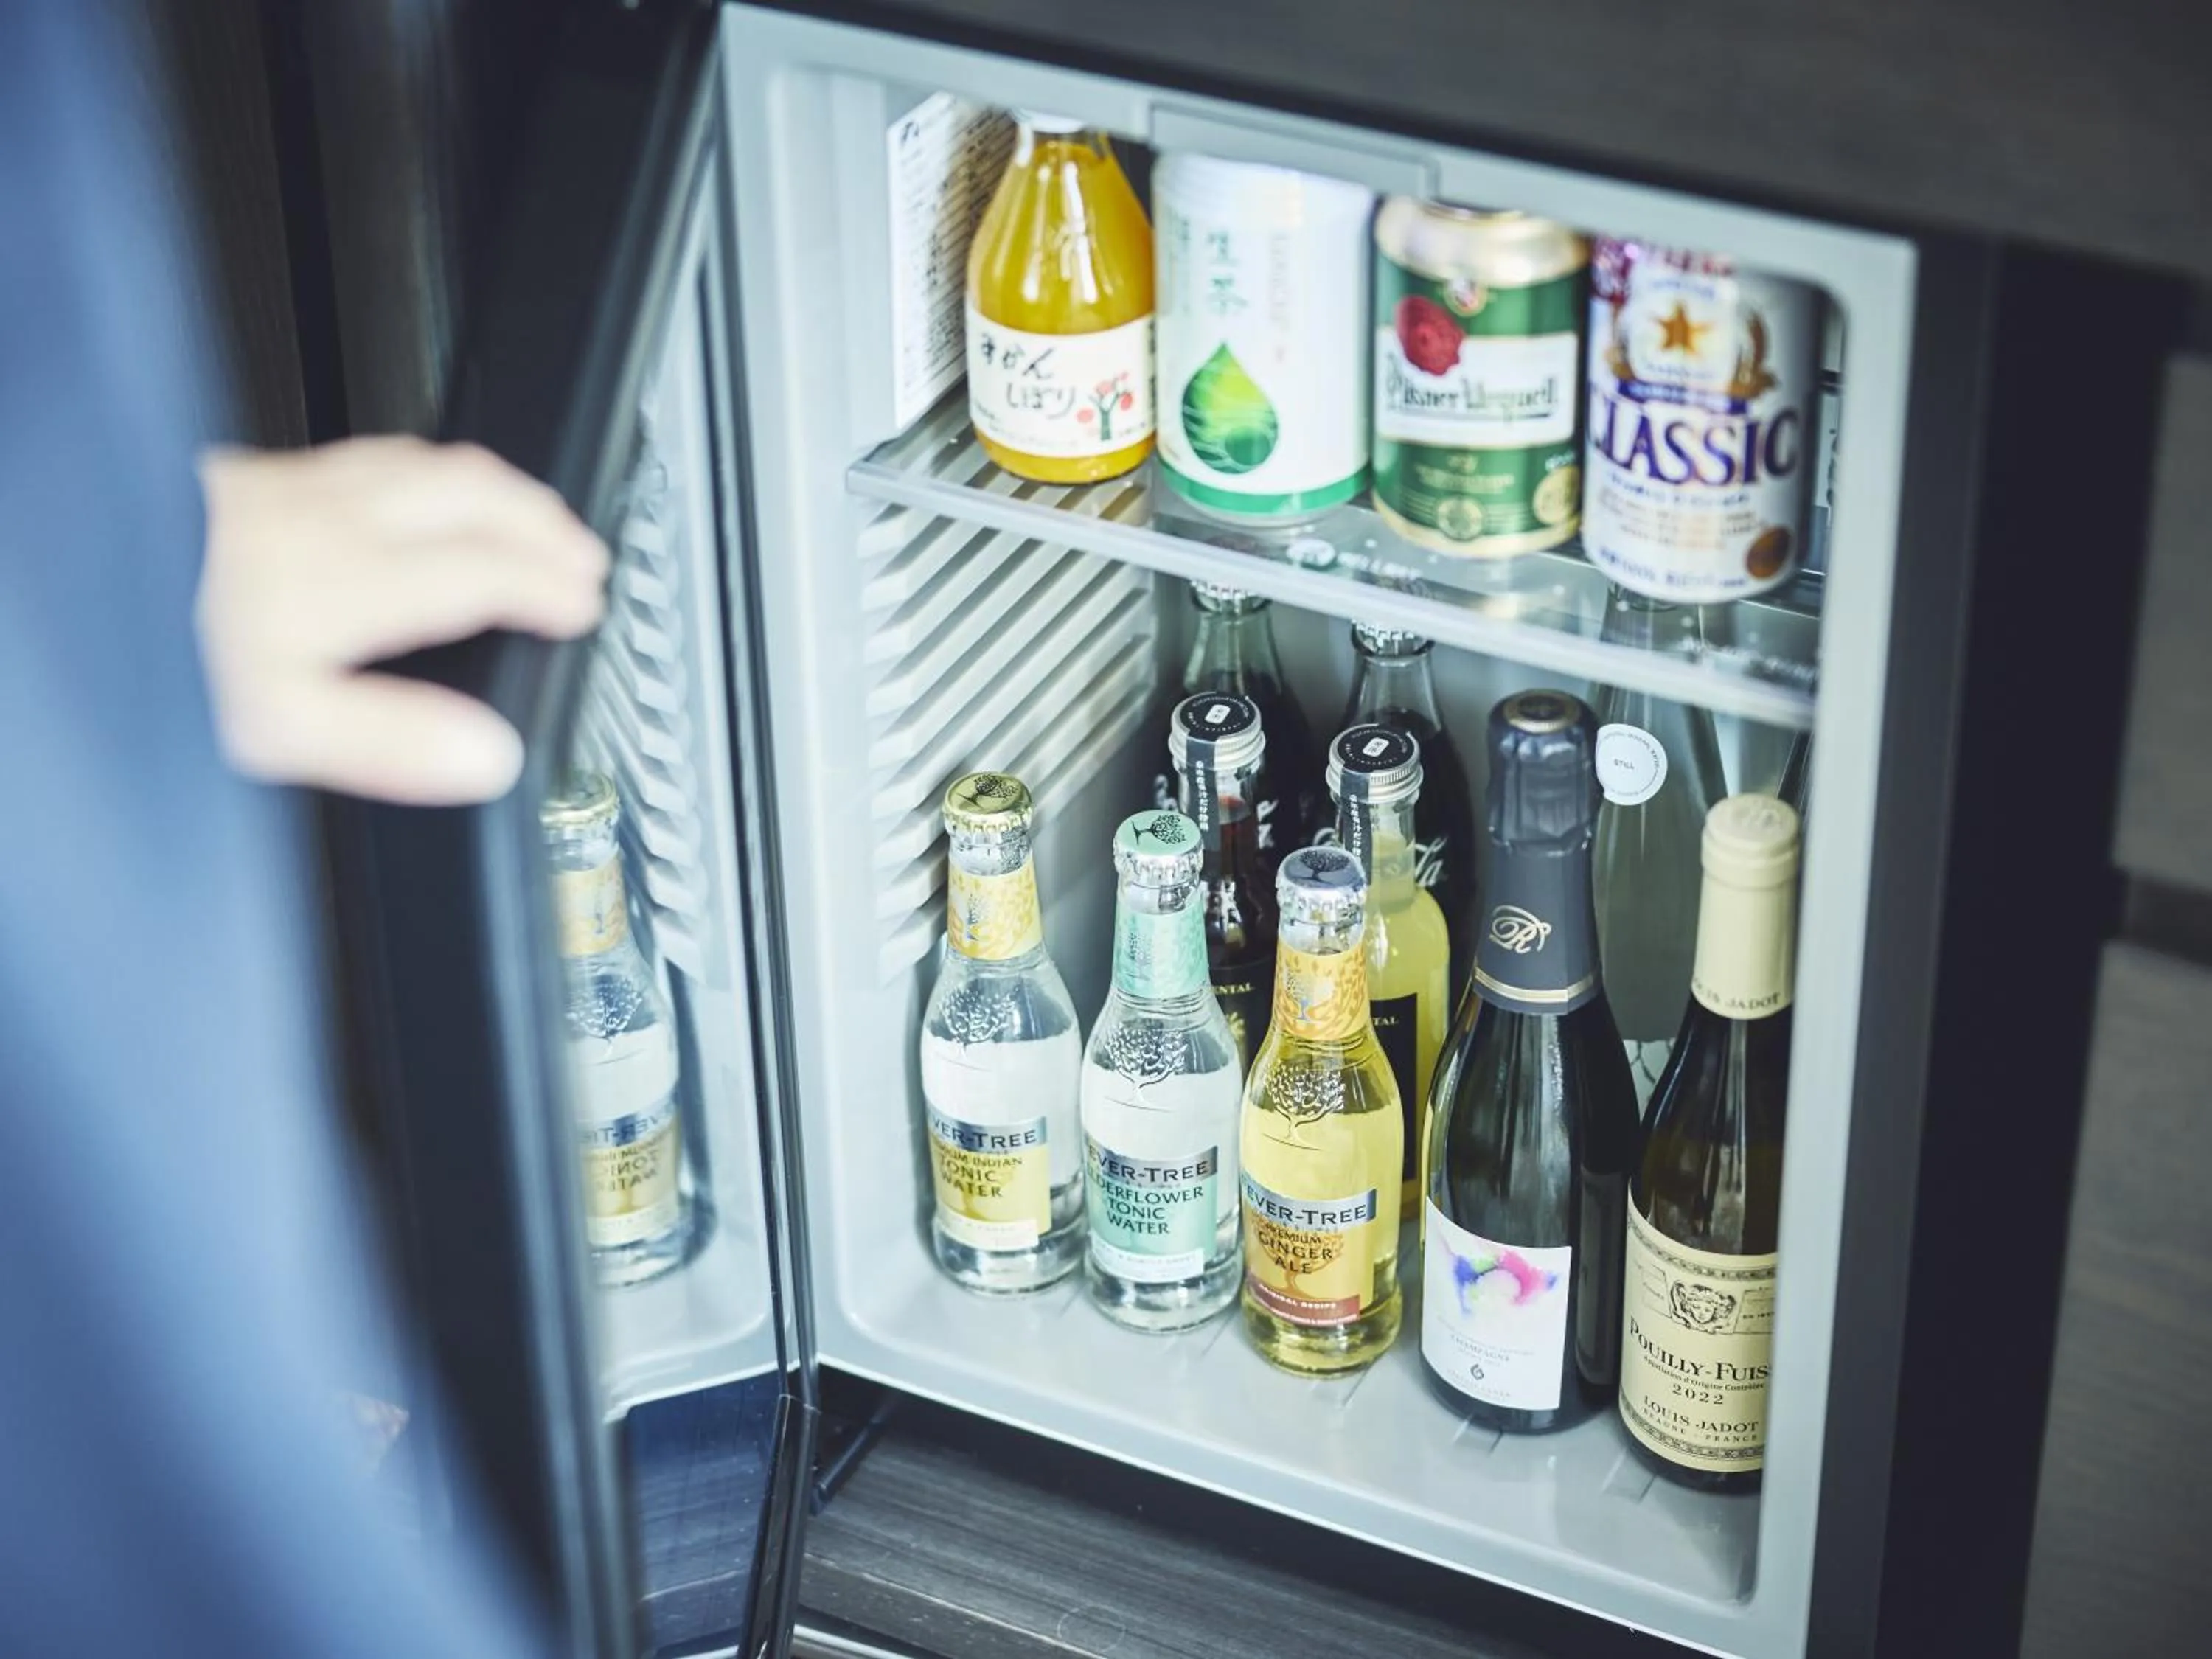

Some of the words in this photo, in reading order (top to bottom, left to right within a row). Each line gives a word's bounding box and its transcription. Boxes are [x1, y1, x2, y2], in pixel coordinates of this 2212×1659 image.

[1210, 981, 1256, 995] ENTAL
[1725, 990, 1781, 1010] JADOT
[932, 1113, 1037, 1148] VER-TREE
[940, 1154, 998, 1182] TONIC
[973, 1155, 1023, 1167] INDIAN
[1088, 1144, 1208, 1182] EVER-TREE
[942, 1171, 1003, 1198] WATER
[1107, 1196, 1165, 1220] TONIC
[1246, 1183, 1366, 1225] EVER-TREE
[1107, 1211, 1170, 1234] WATER
[1258, 1231, 1333, 1260] GINGER
[1275, 1256, 1312, 1275] ALE
[1629, 1315, 1771, 1381] POUILLY-FUIS
[1672, 1383, 1724, 1405] 2022
[1642, 1406, 1686, 1435] BEAUNE
[1705, 1434, 1758, 1443] FRANCE
[1644, 1394, 1690, 1426] LOUIS
[1695, 1420, 1759, 1433] JADOT
